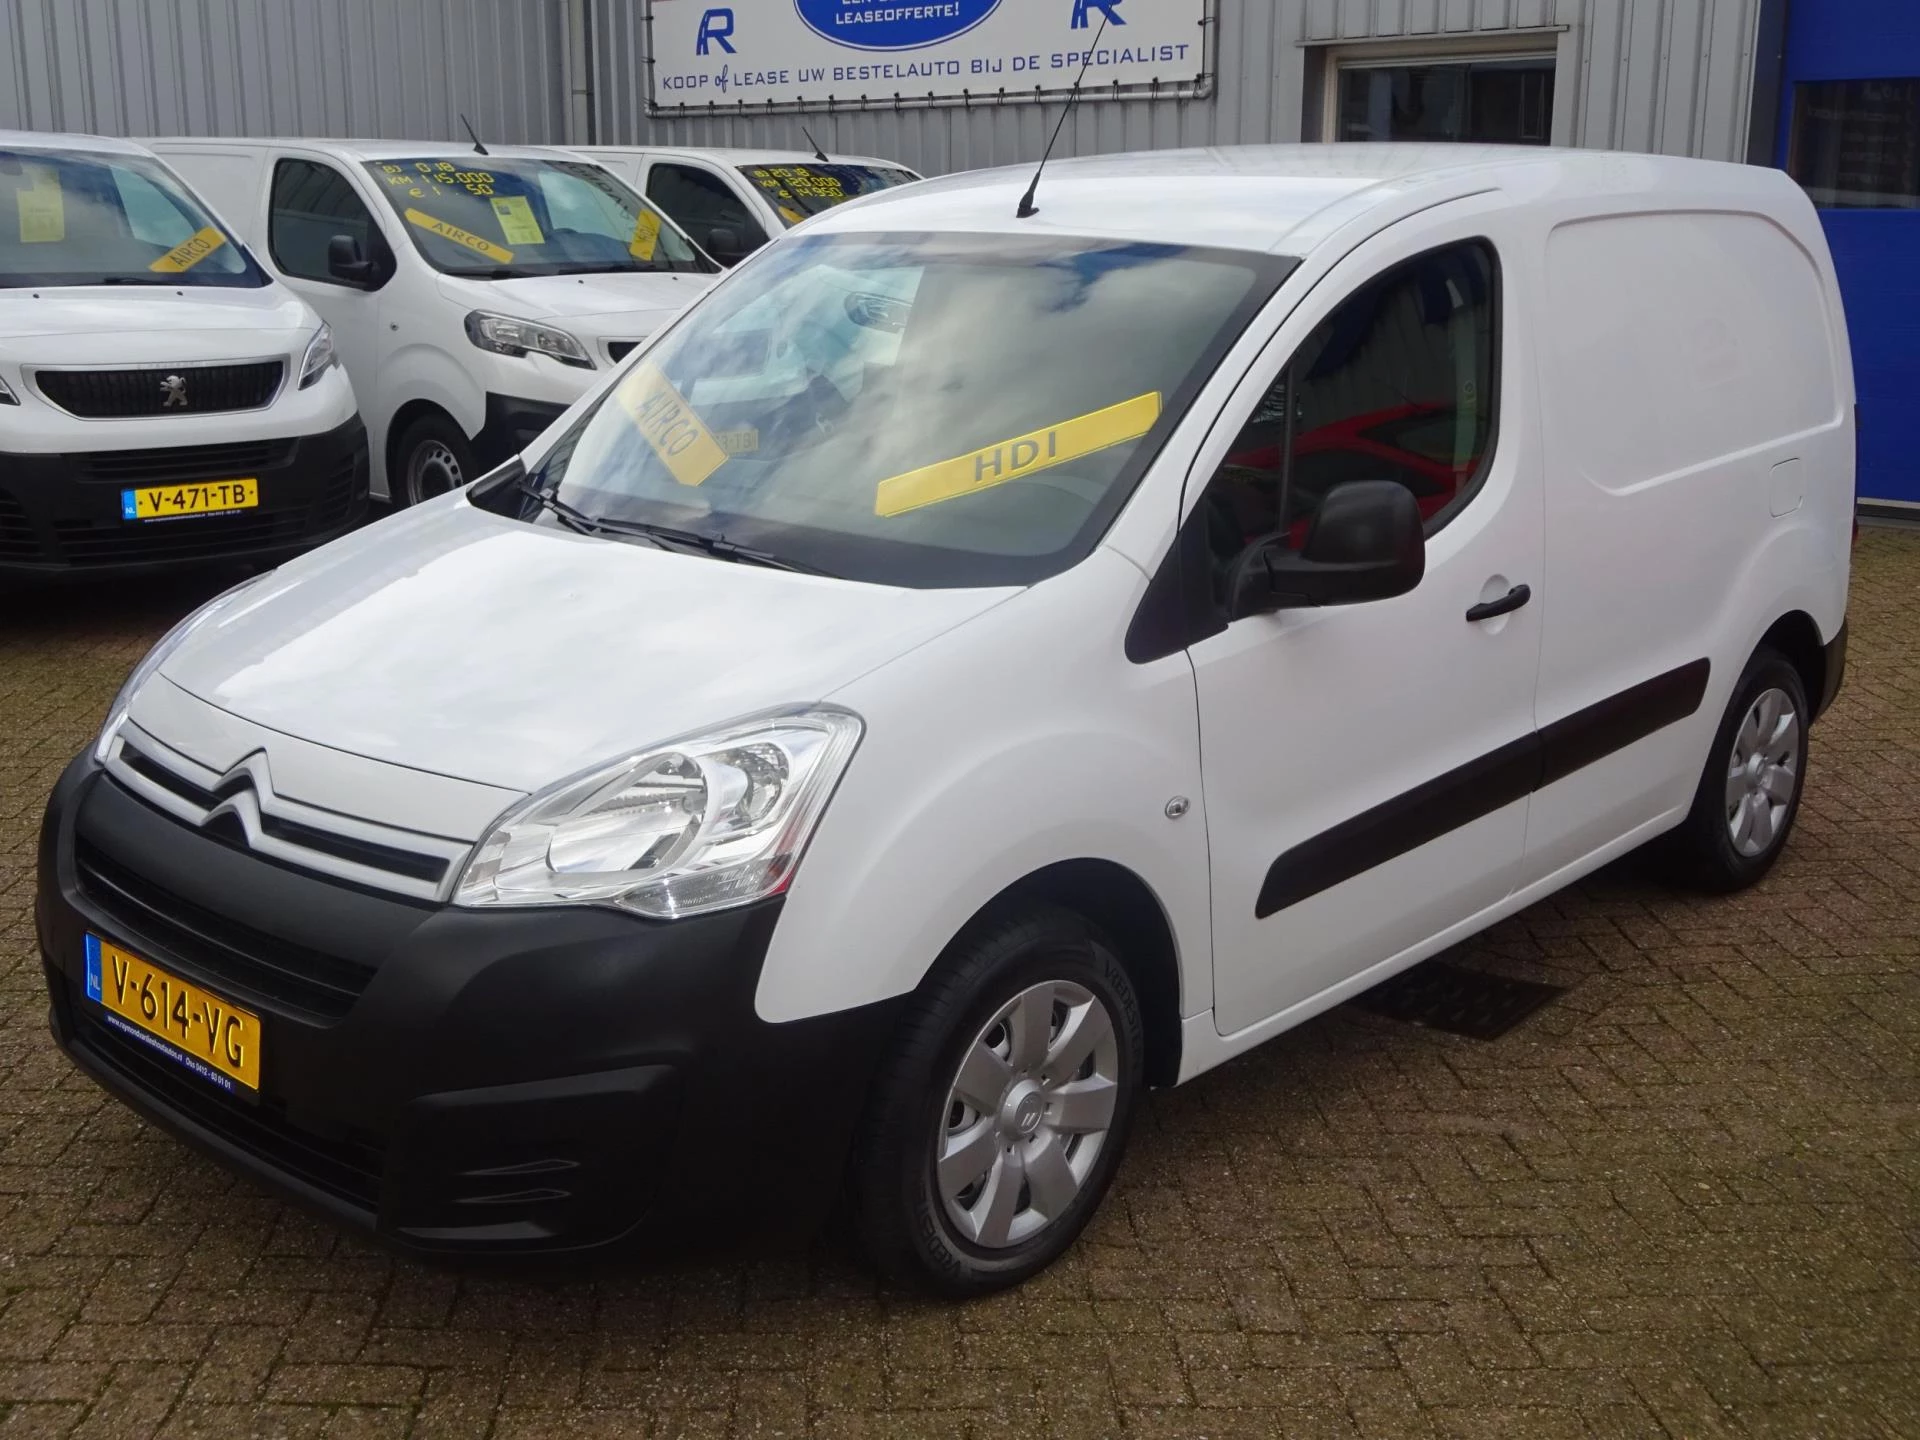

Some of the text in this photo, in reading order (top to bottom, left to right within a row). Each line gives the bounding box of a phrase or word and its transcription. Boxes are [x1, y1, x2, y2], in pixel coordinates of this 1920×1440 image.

[836, 2, 959, 26] LEASEOFFERTE!
[663, 44, 1189, 93] KOOP of LEASE UW BESTELAUTO BIJ DE SPECIALIST
[386, 175, 414, 186] KM
[432, 222, 490, 251] AIRCO
[169, 238, 210, 267] AIRCO
[635, 391, 699, 456] AIRCO
[974, 430, 1058, 483] HDI
[125, 484, 246, 515] NL V-471-TB
[88, 953, 245, 1070] NL V-614-VG
